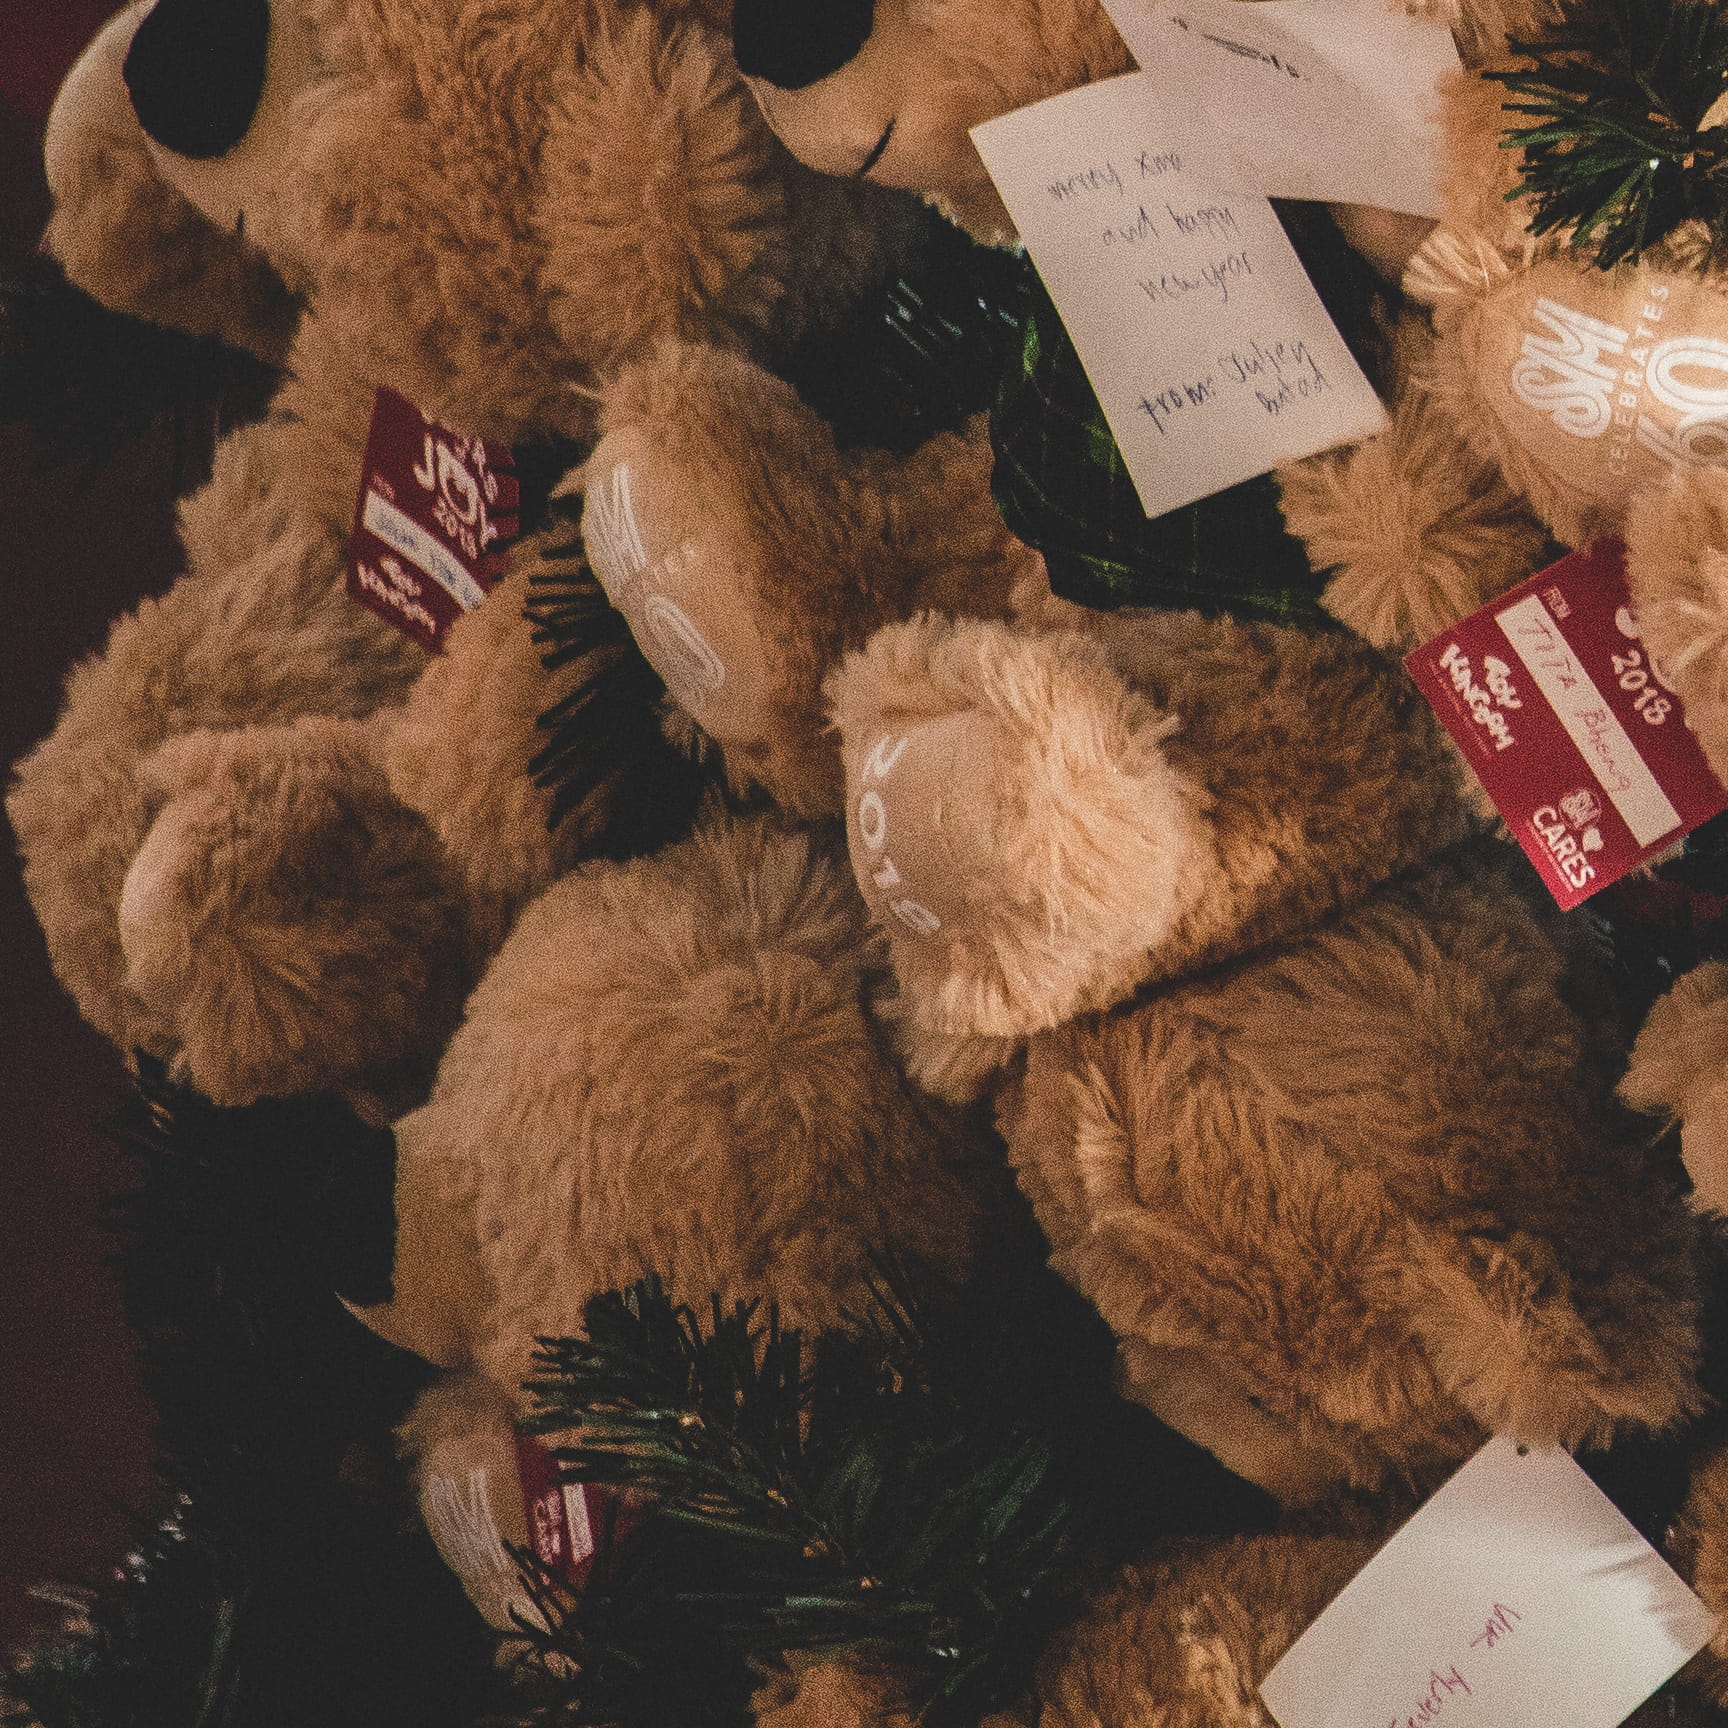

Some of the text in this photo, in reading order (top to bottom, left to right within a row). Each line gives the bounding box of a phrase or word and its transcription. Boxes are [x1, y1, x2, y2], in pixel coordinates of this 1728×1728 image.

[1511, 297, 1630, 439] SM
[1439, 644, 1516, 751] KINGDOM
[1483, 655, 1523, 710] TOY
[1610, 649, 1672, 726] 2018
[1532, 805, 1596, 889] CARES
